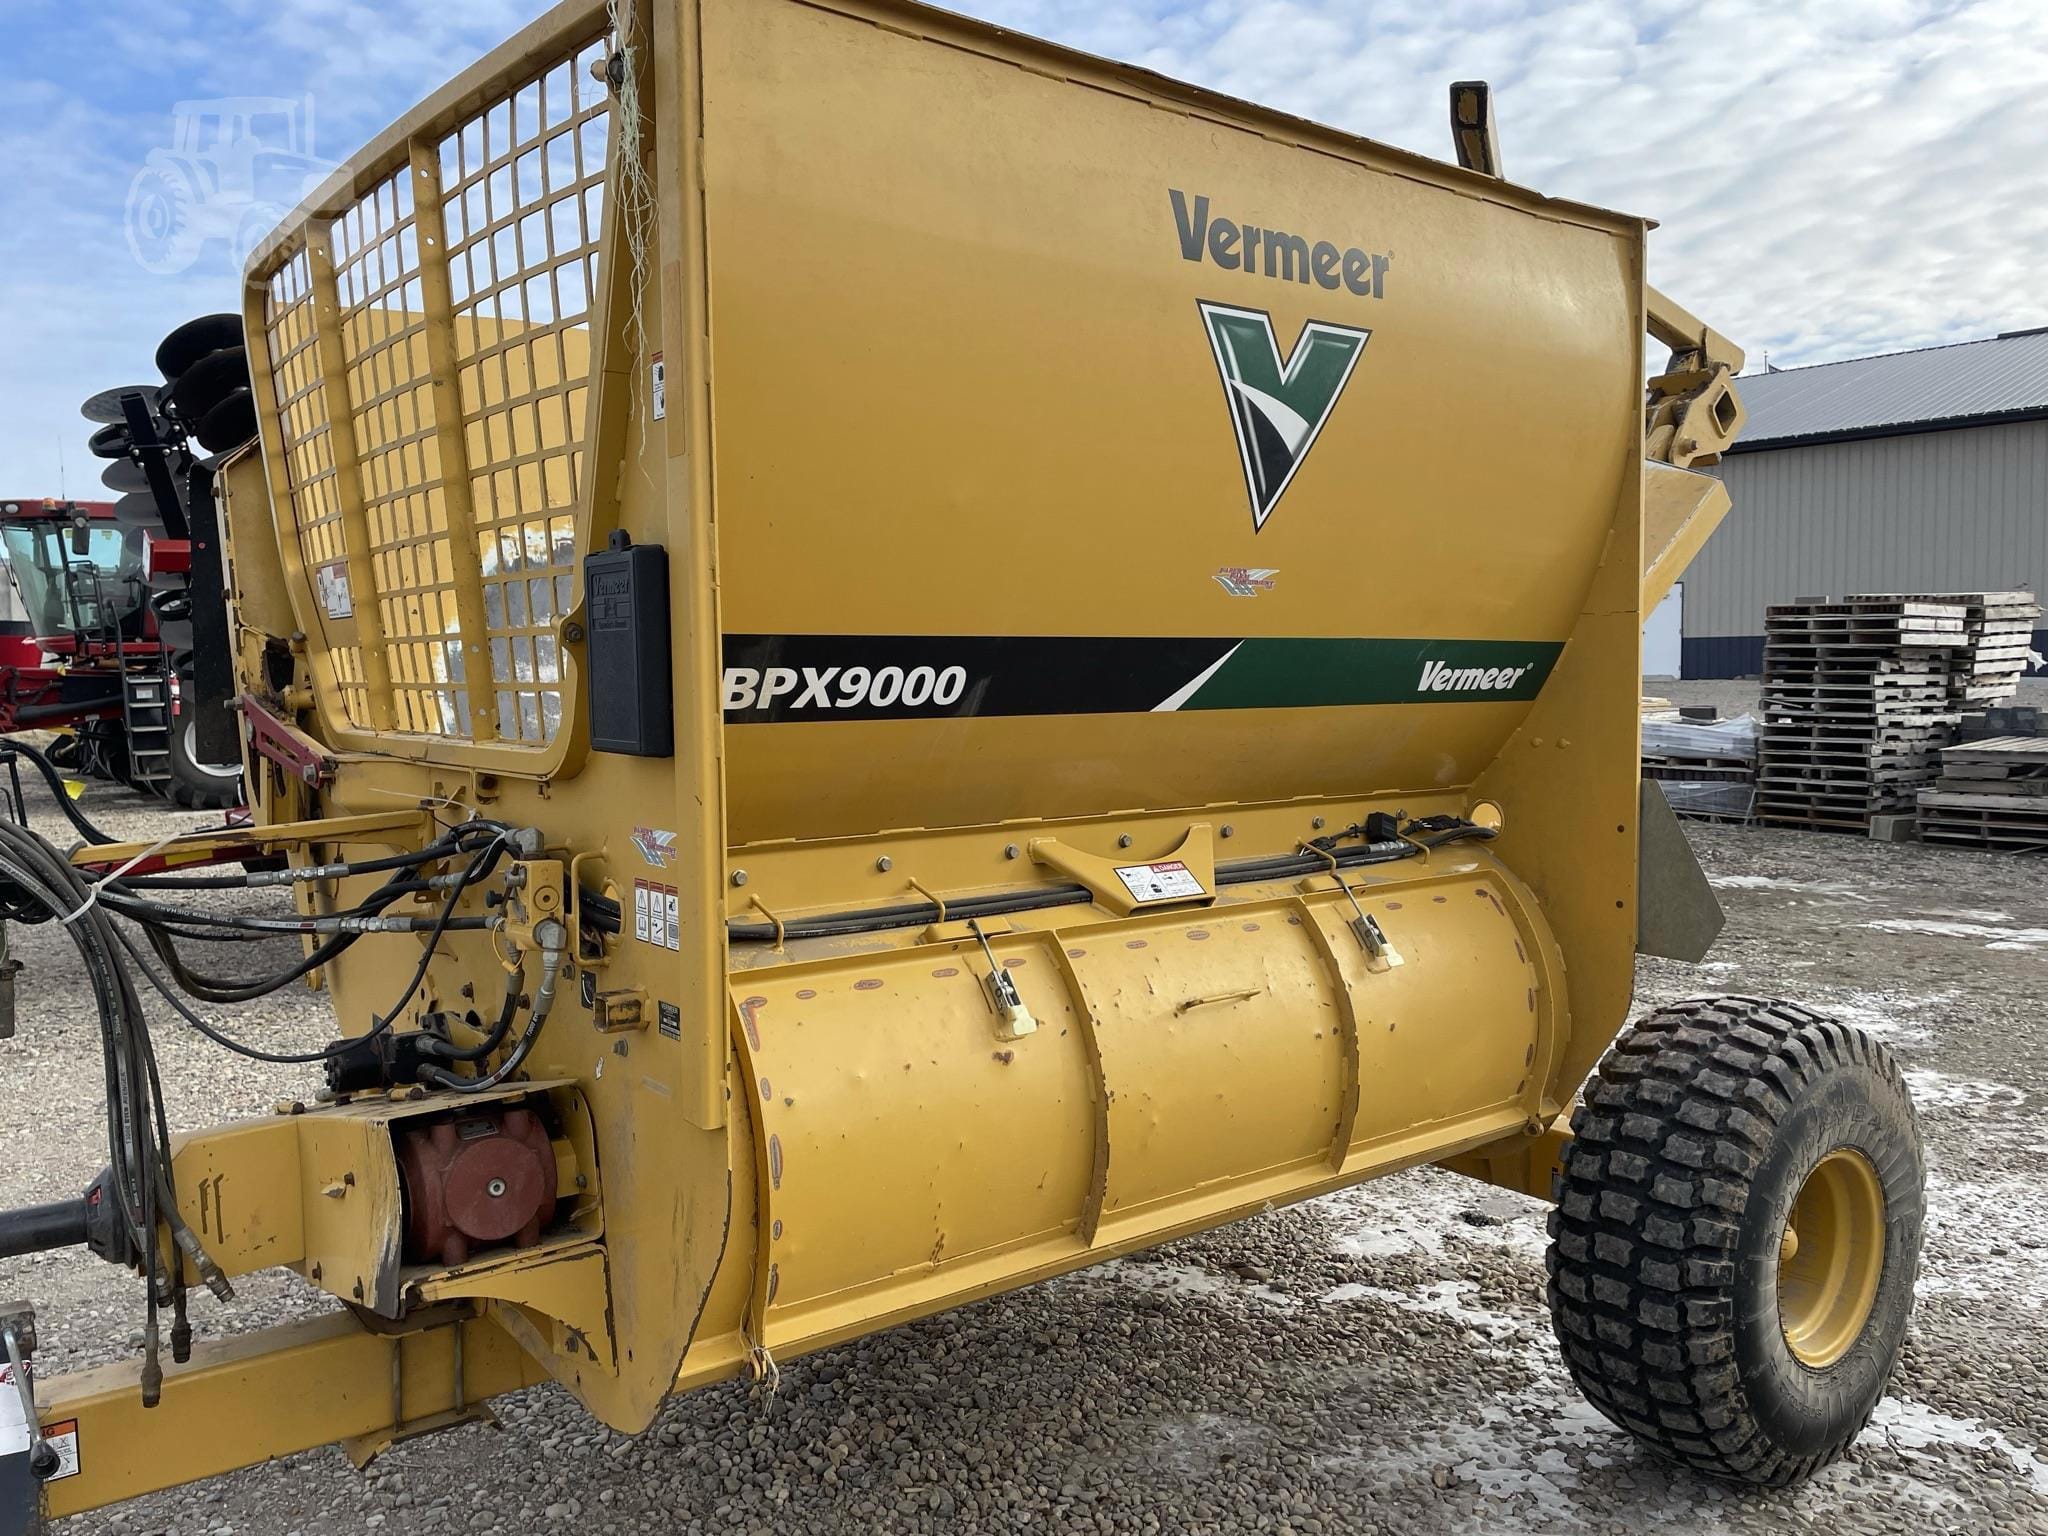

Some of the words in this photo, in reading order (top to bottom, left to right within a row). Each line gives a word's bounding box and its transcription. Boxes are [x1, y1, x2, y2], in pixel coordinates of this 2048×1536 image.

[1168, 188, 1389, 299] Vermeer
[592, 573, 629, 597] Vermeer
[723, 665, 967, 710] BPX9000
[1417, 660, 1526, 692] Vermeer
